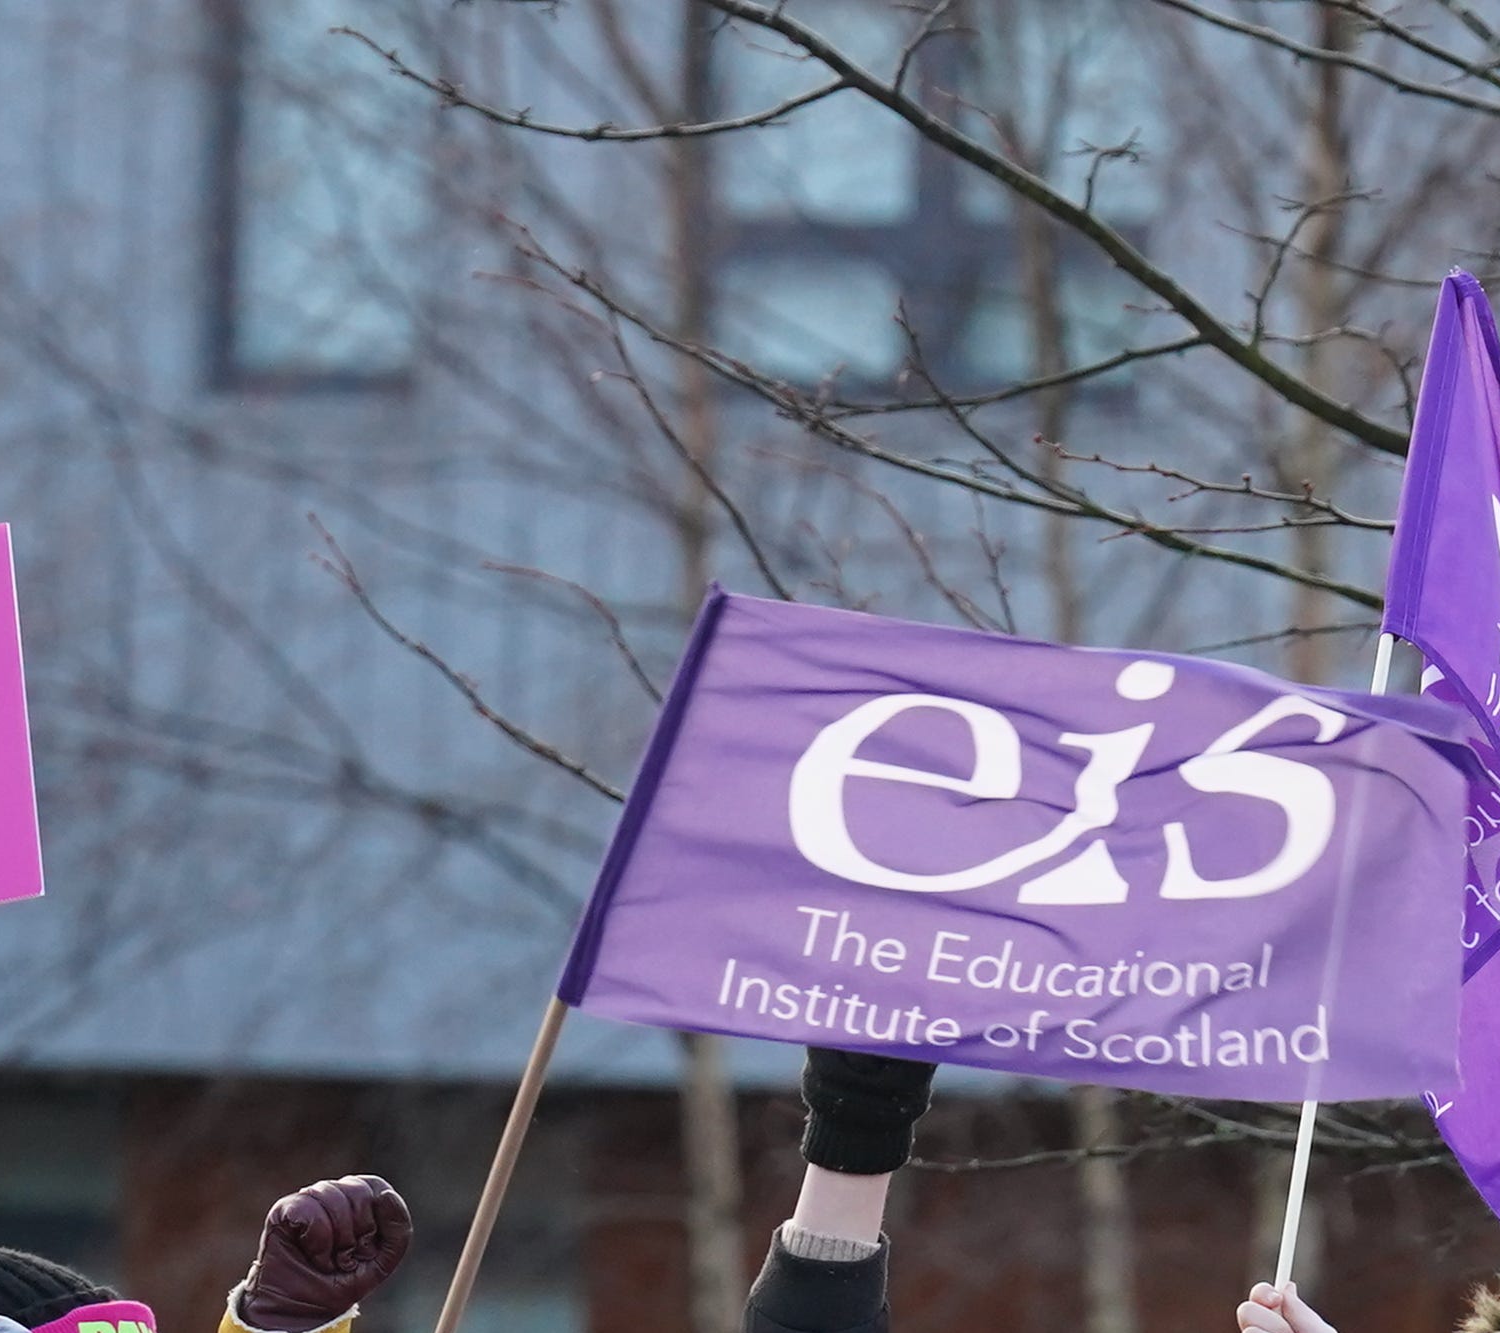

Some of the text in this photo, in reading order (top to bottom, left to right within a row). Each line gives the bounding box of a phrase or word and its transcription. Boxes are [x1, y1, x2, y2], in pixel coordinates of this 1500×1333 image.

[788, 660, 1346, 905] eis
[795, 905, 1272, 998] The Educational
[717, 958, 1331, 1068] Institute of Scotland
